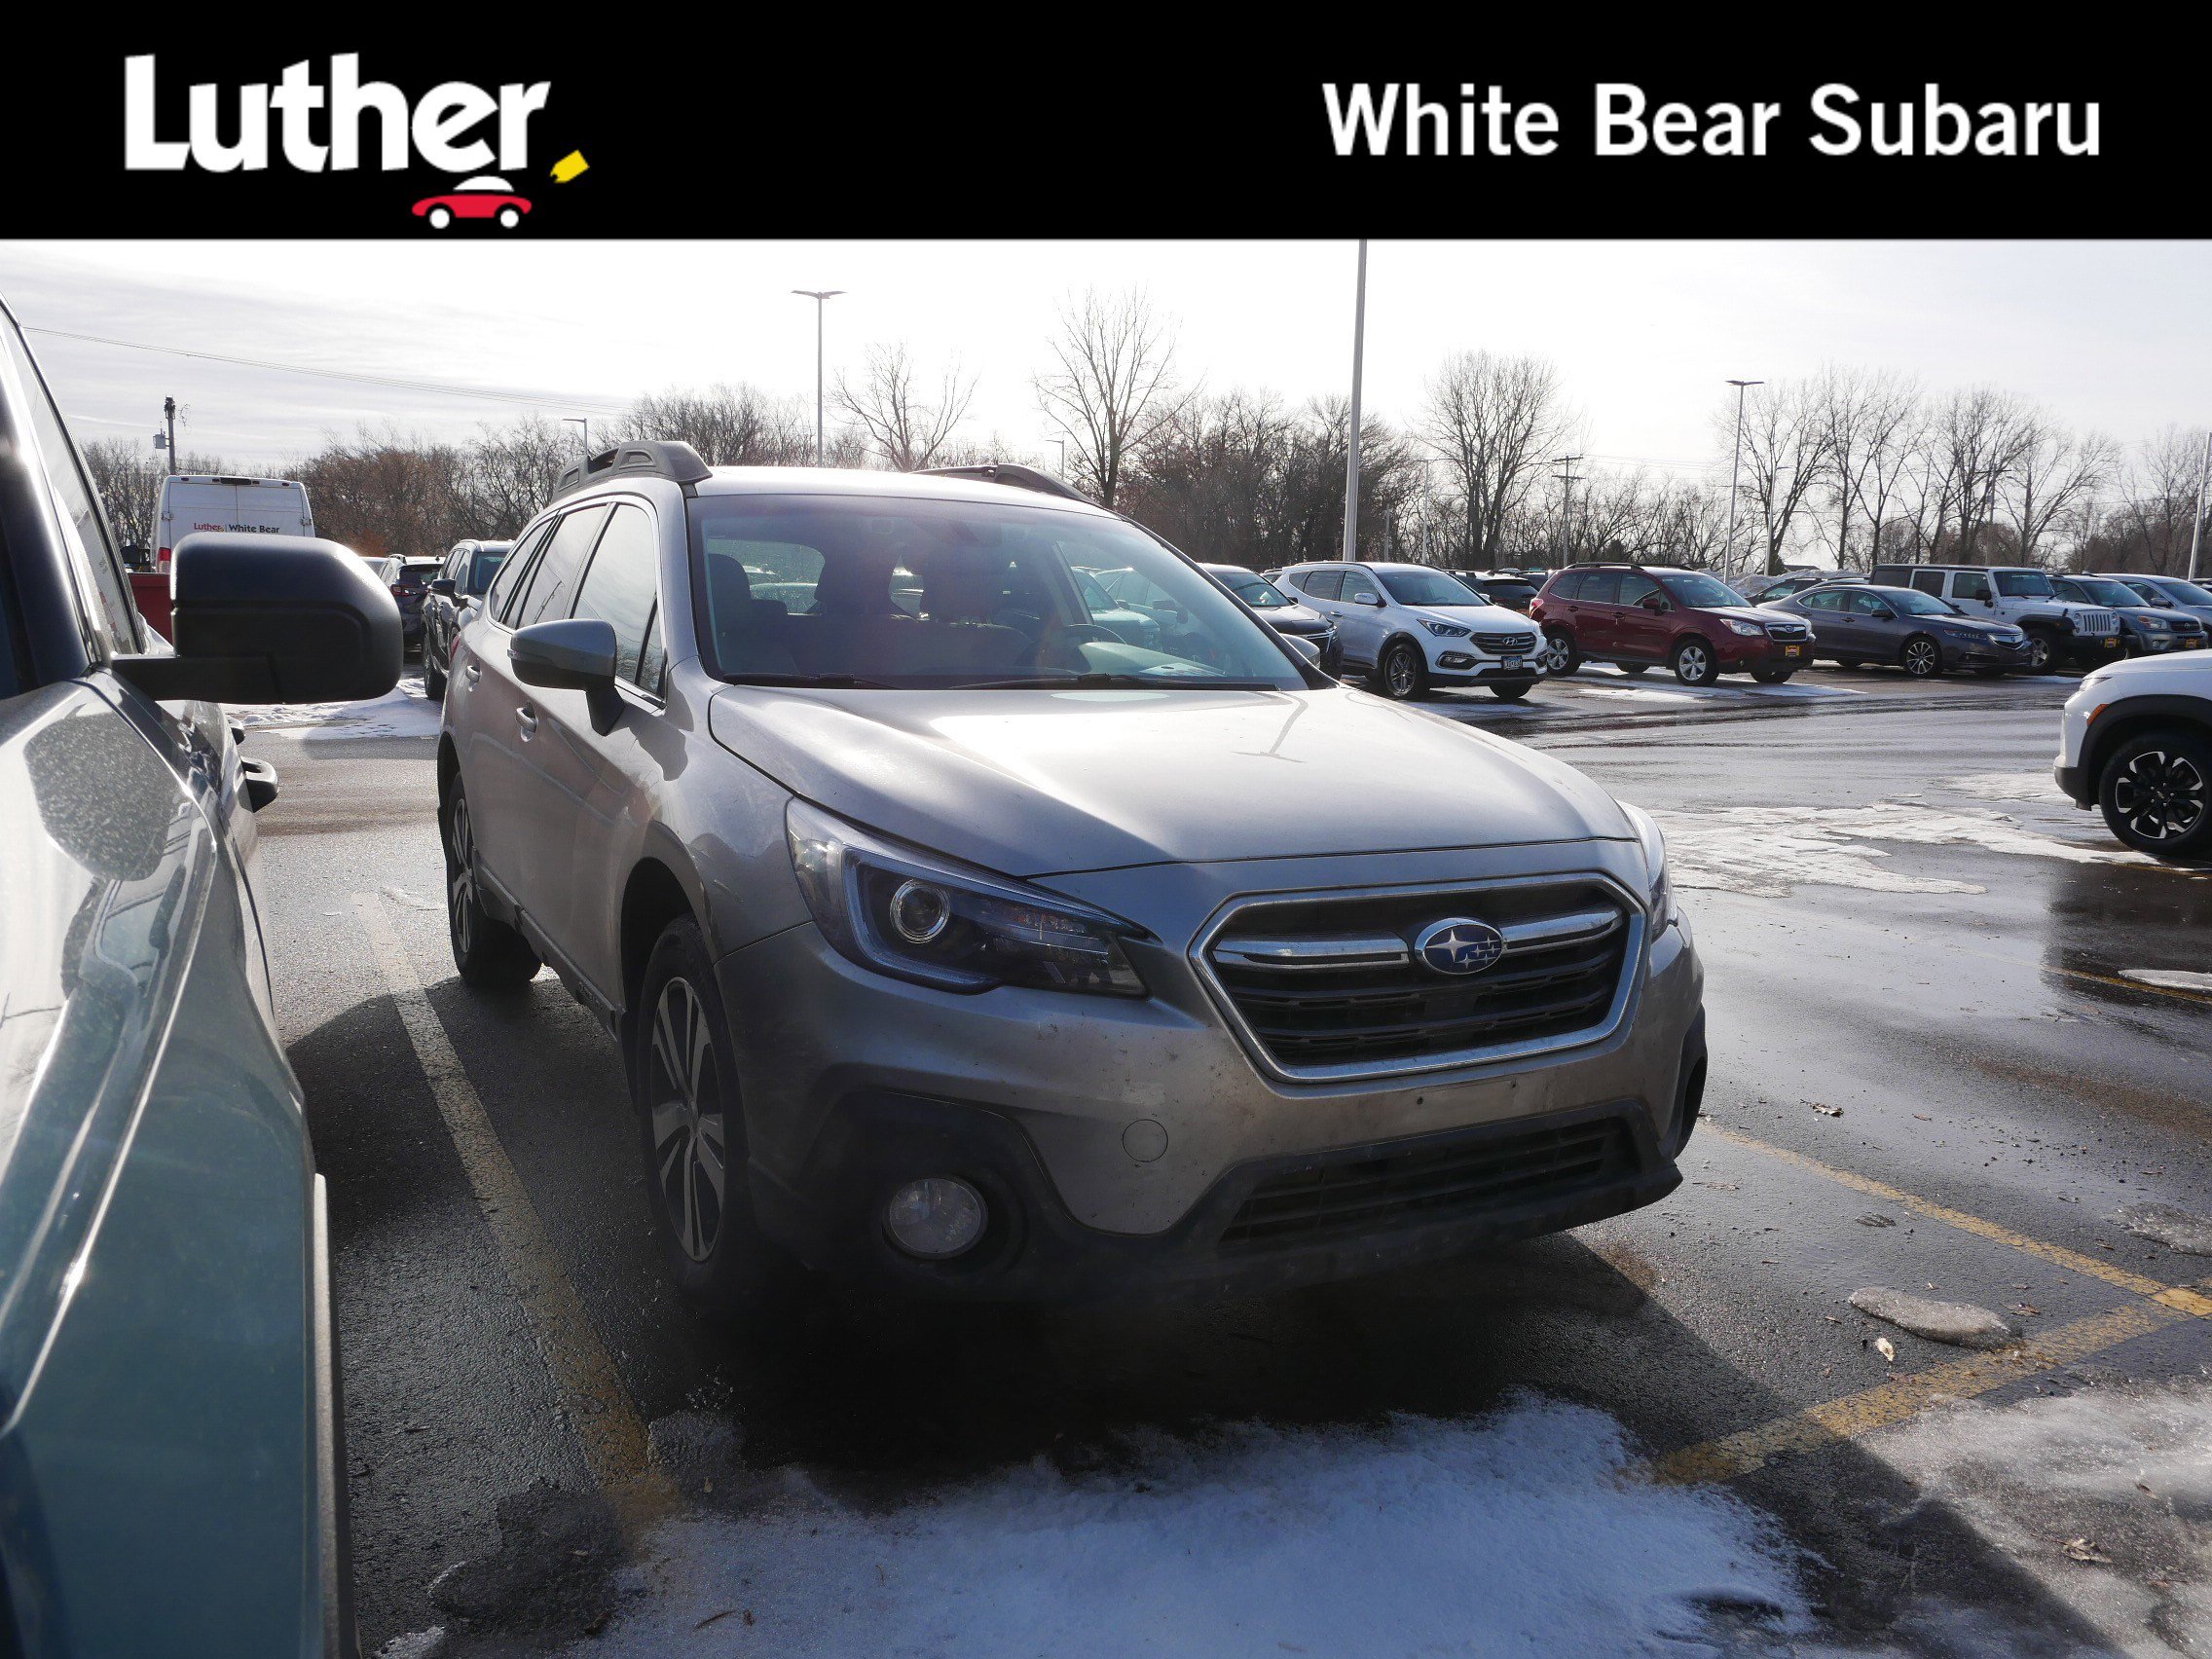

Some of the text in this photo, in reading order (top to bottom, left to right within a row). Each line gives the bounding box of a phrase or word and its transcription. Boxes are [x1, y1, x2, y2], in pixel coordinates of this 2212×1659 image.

[194, 523, 280, 534] Luther White Bear
